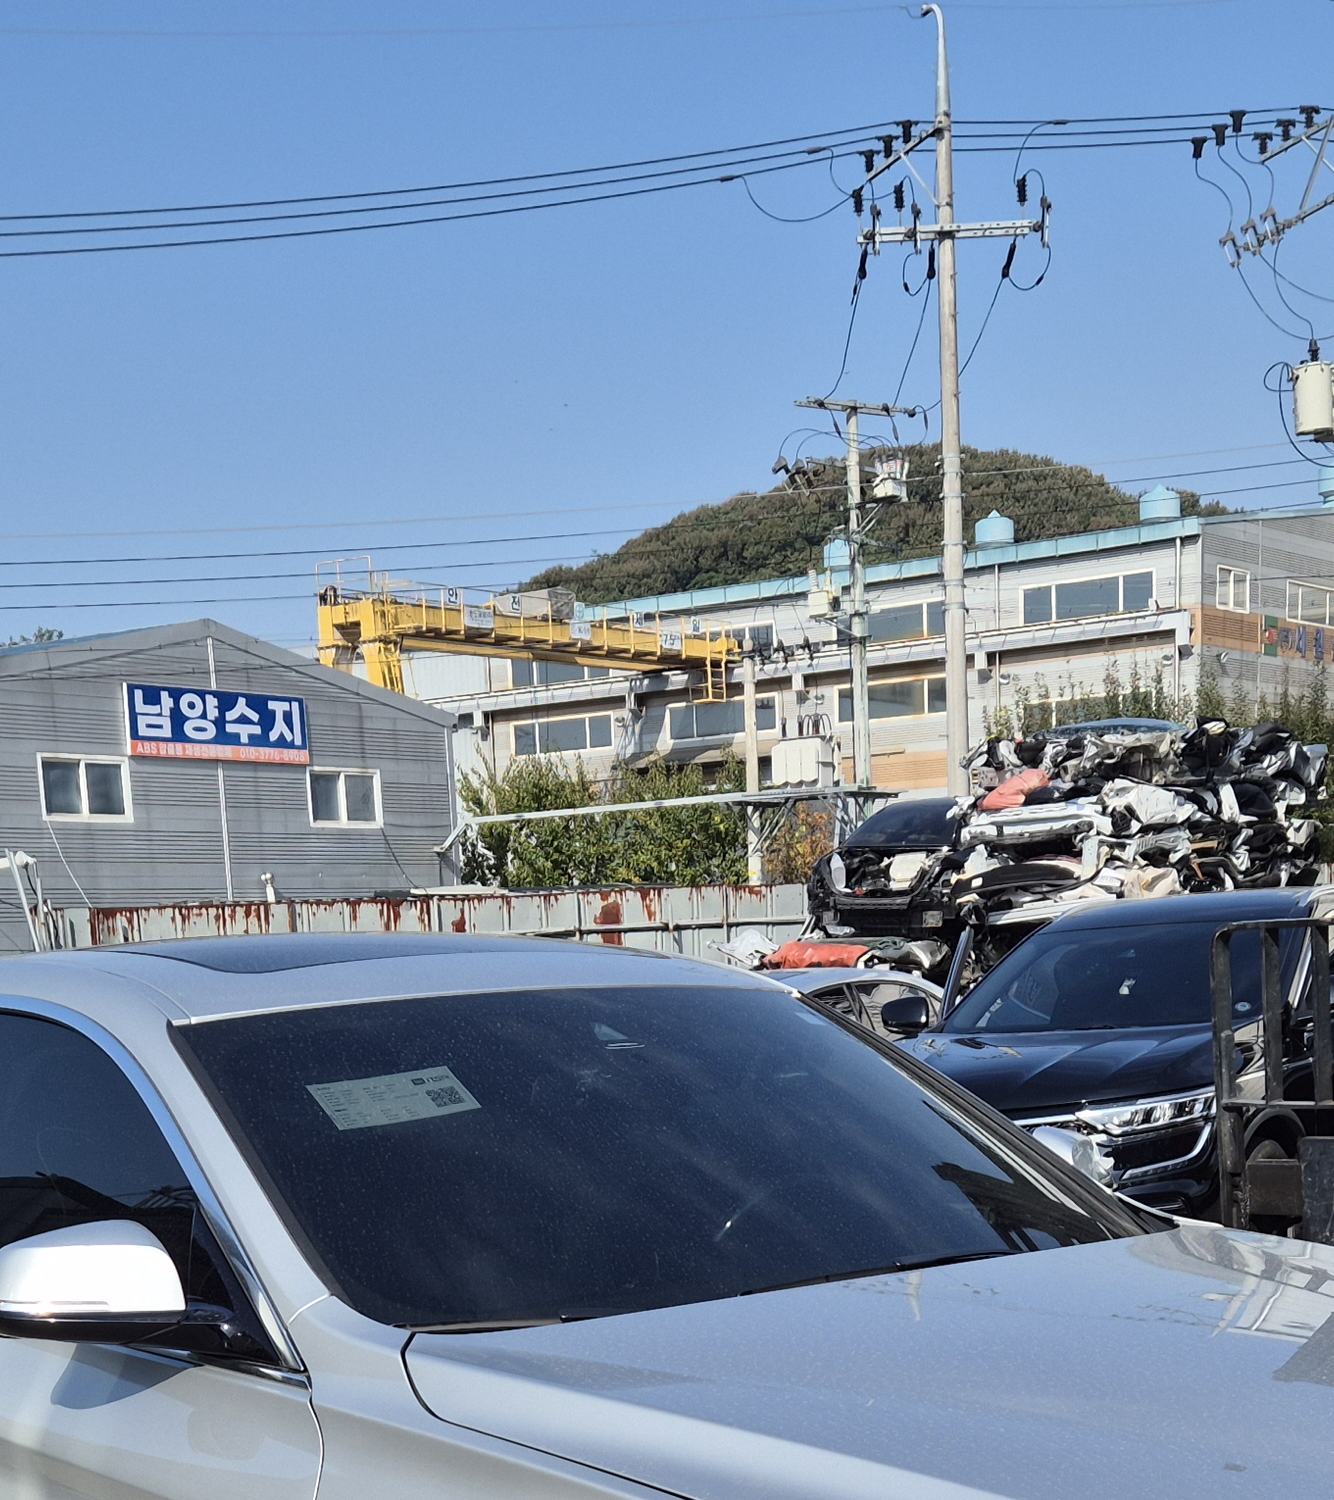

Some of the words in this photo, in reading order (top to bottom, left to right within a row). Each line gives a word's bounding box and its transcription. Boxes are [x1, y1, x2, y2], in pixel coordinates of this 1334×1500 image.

[447, 587, 458, 604] 안
[510, 595, 521, 611] 전
[133, 688, 303, 746] 남양수지
[136, 743, 157, 755] ABS
